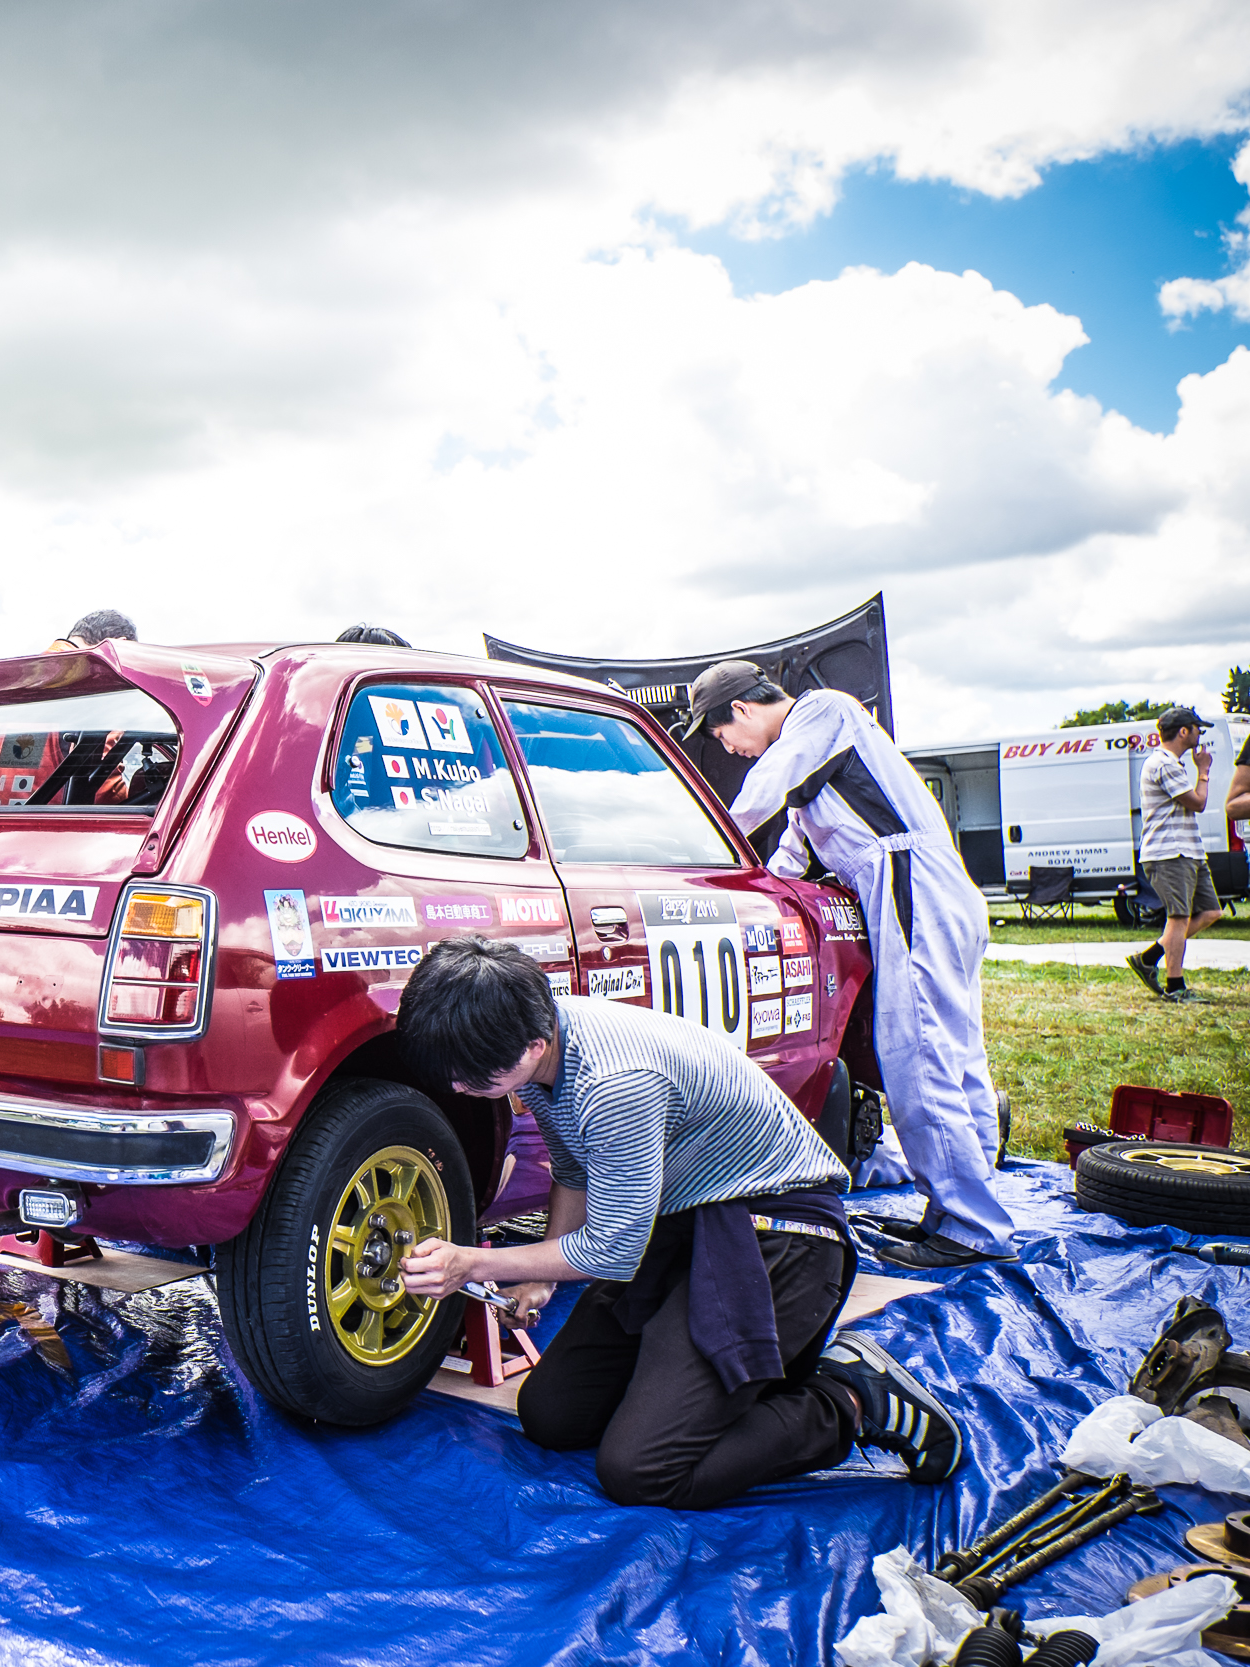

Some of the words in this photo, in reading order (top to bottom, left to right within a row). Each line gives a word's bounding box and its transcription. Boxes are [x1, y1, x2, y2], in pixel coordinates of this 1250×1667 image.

[1003, 742, 1054, 759] BUY
[1056, 738, 1098, 755] ME
[411, 756, 482, 783] M.Kubo
[420, 787, 491, 817] S.Nagai
[251, 826, 312, 846] Henkel
[1027, 850, 1071, 858] ANDREW
[1075, 848, 1108, 856] SIMMS
[1047, 857, 1088, 865] BOTANY
[500, 898, 559, 922] MOTUL
[693, 900, 719, 918] 2016
[783, 922, 801, 940] KTC
[324, 949, 421, 968] VIEWTEC
[785, 959, 811, 979] ASAHI
[660, 936, 741, 1034] 010
[753, 1006, 780, 1026] kyowa
[307, 1224, 320, 1332] DUNLOP
